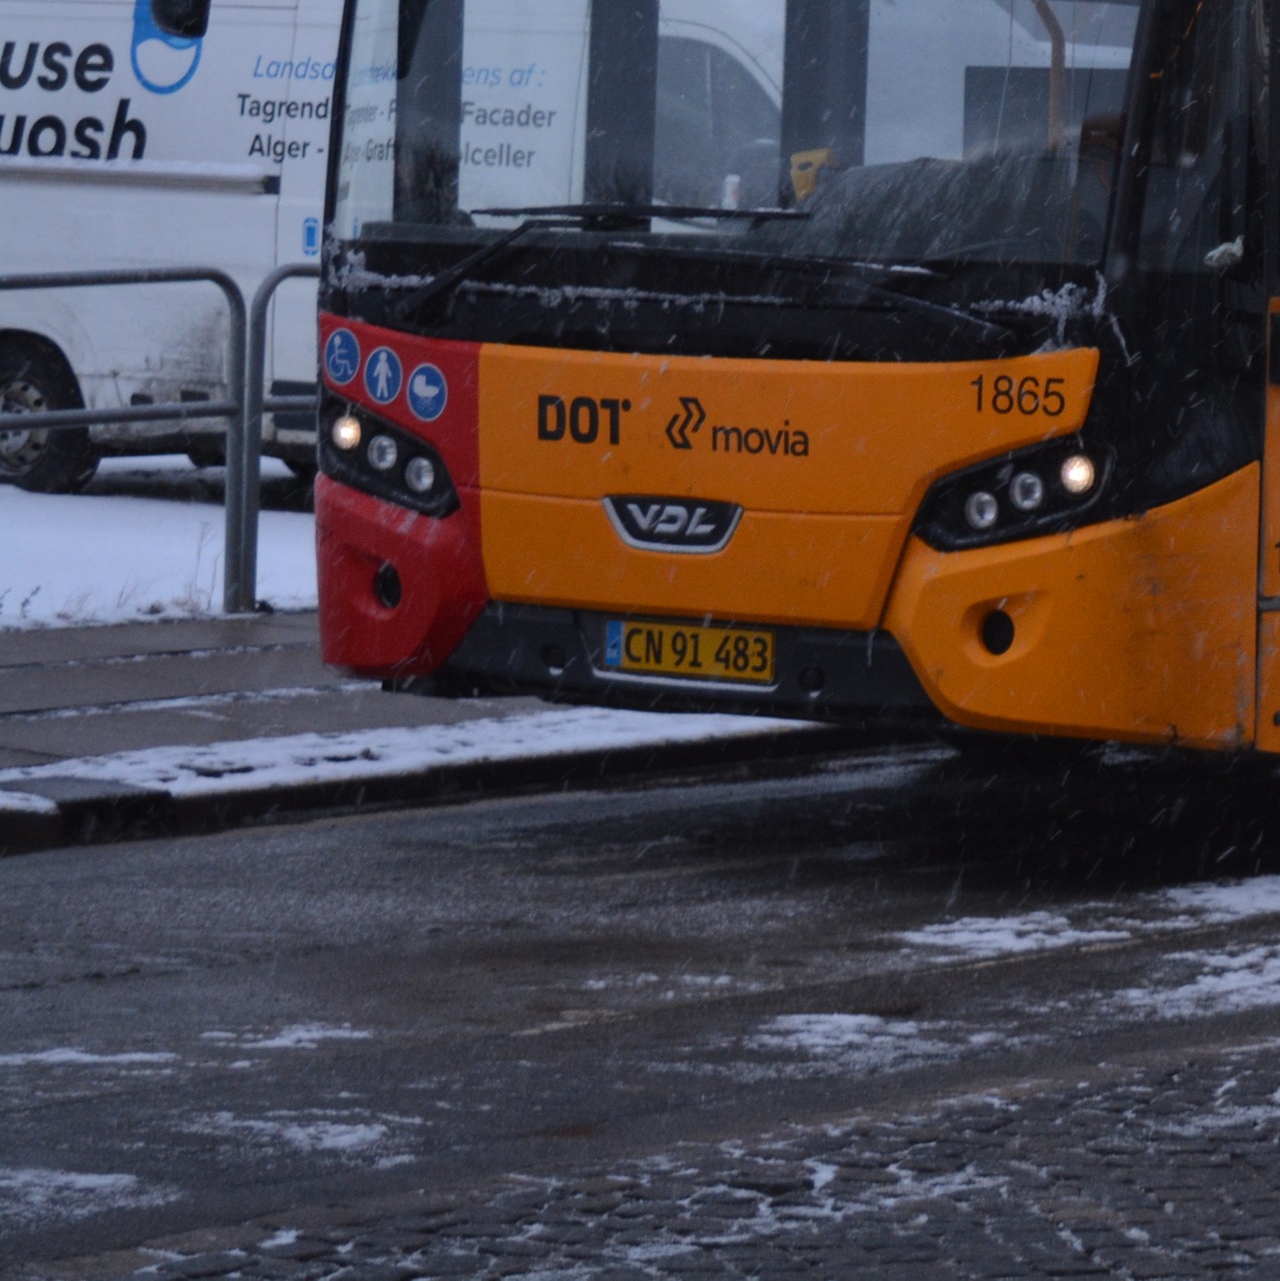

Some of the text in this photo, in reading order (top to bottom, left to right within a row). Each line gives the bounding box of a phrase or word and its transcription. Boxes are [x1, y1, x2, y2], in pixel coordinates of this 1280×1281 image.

[460, 101, 557, 127] Facader
[248, 134, 311, 163] Alger
[460, 141, 536, 167] lceller
[970, 374, 1066, 417] 1865
[537, 394, 631, 446] DOT
[711, 419, 810, 457] movia
[626, 503, 717, 536] VDL
[624, 627, 769, 673] CN 91 483
